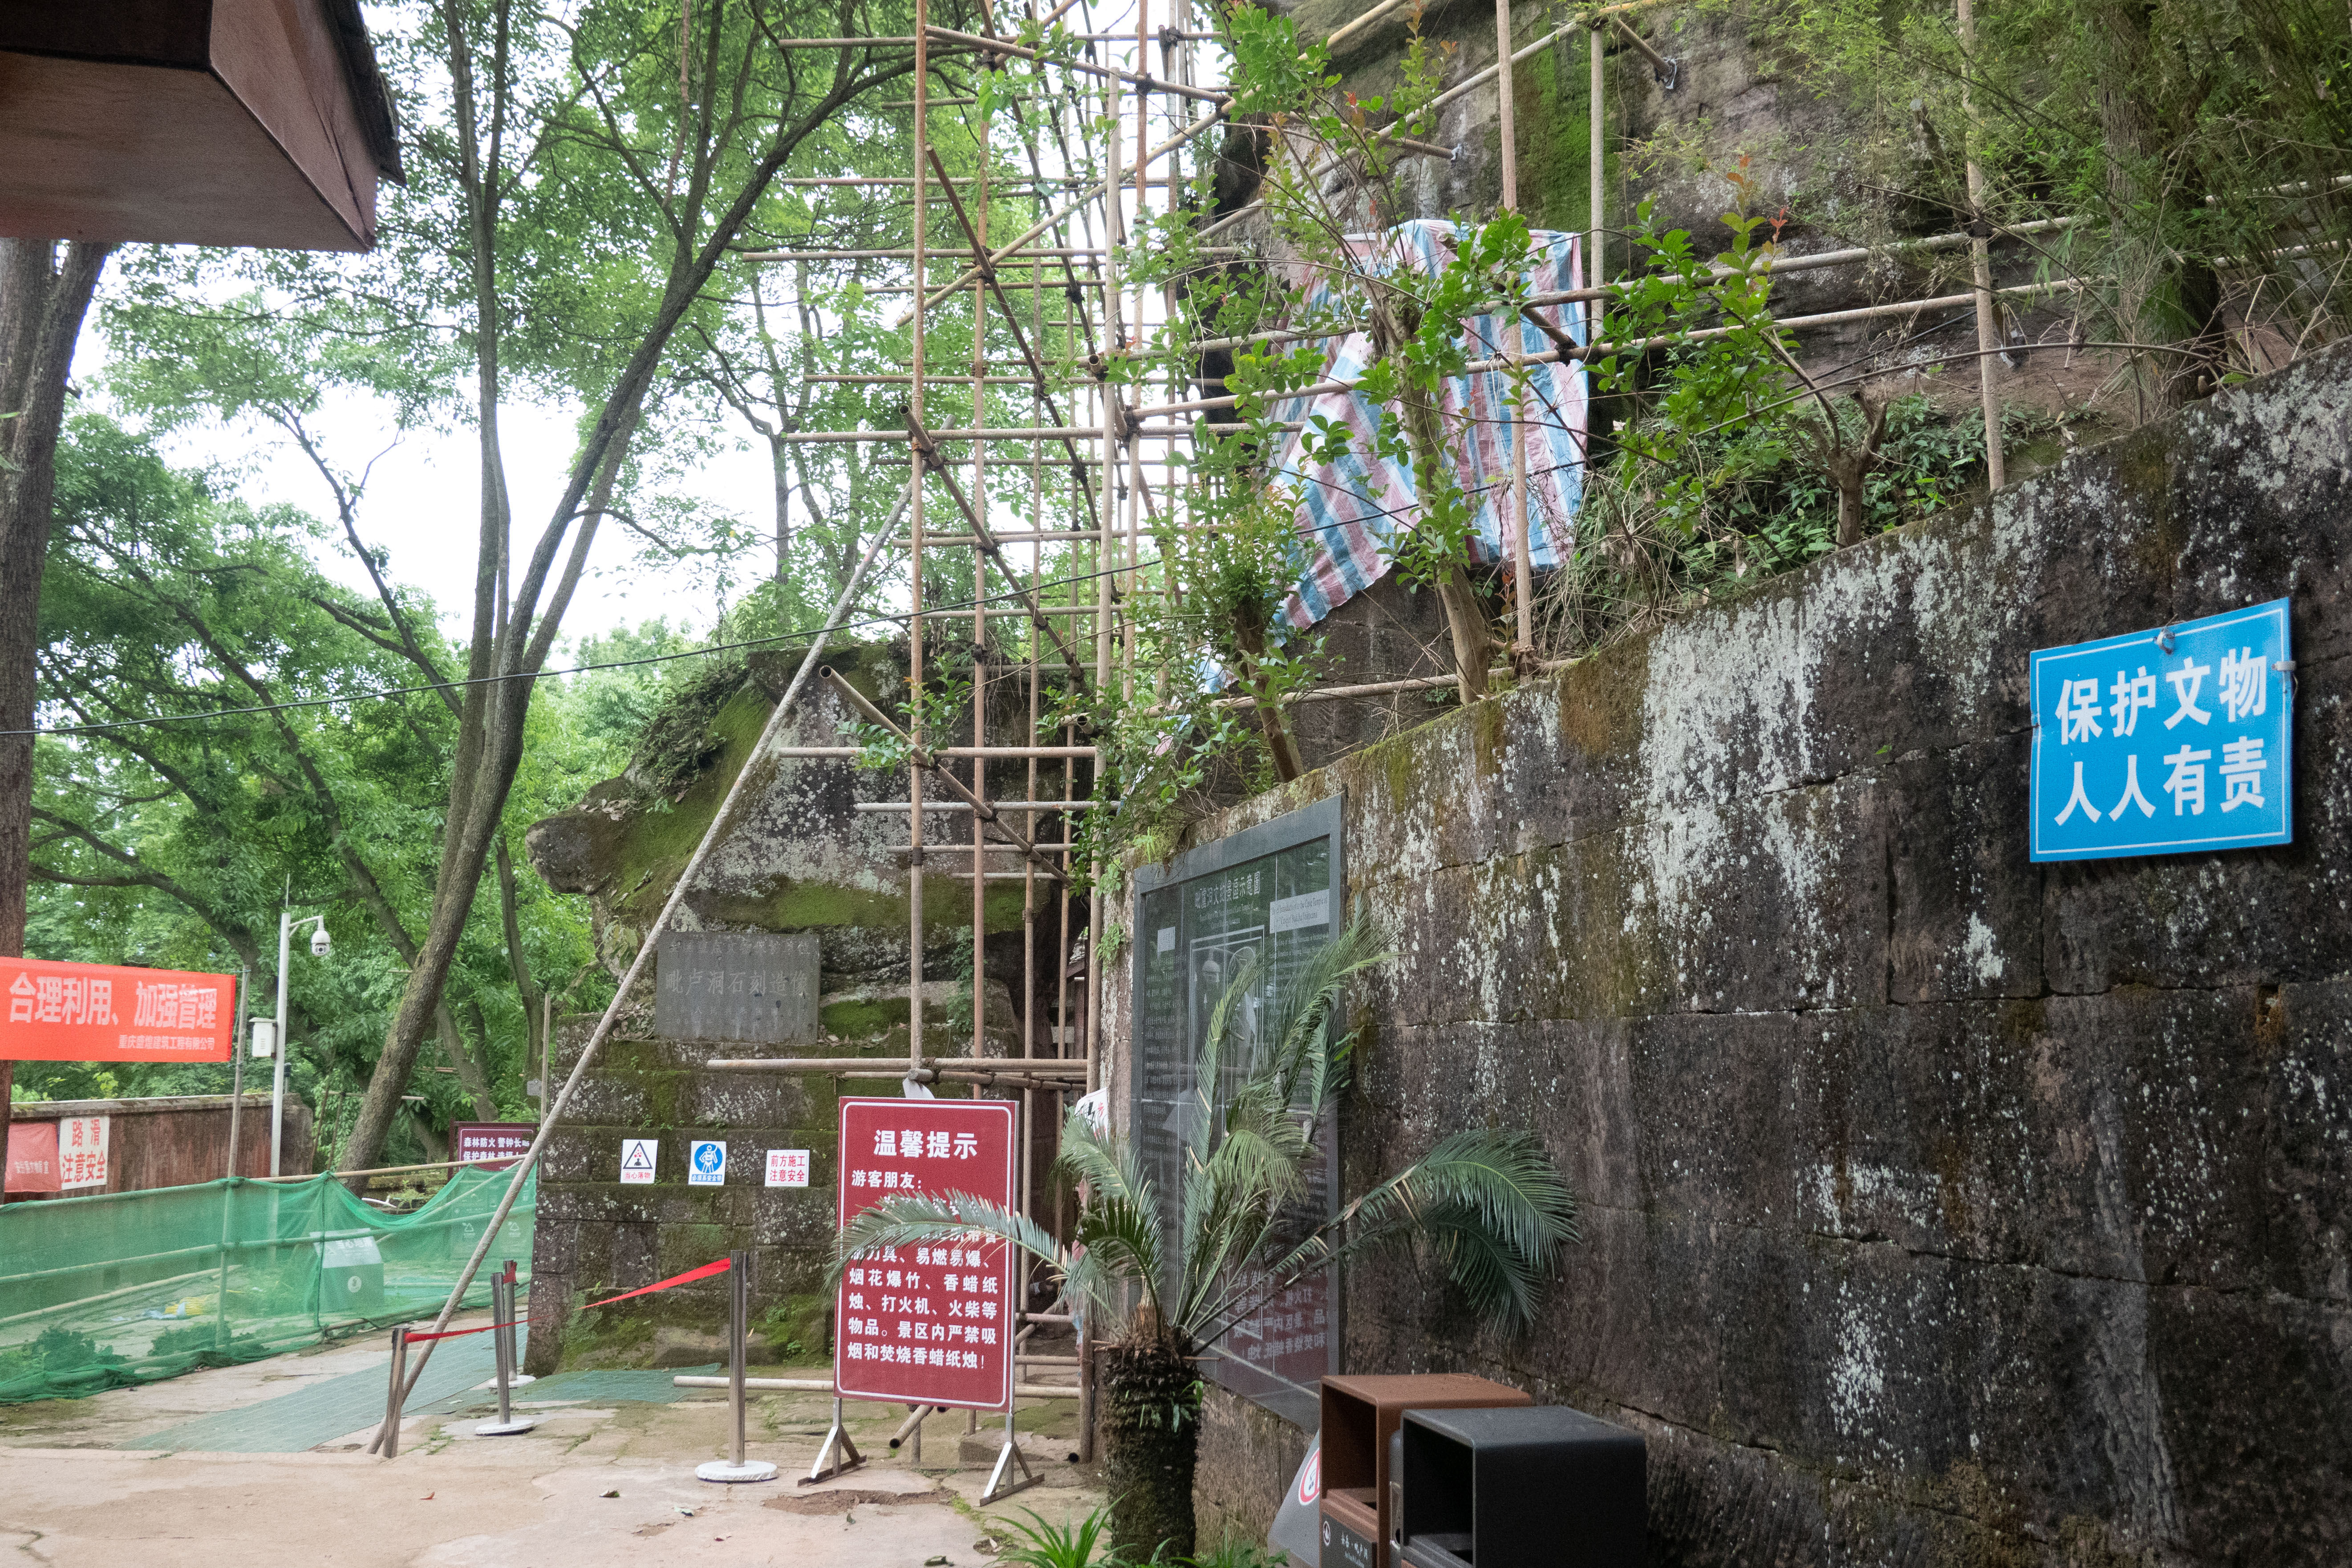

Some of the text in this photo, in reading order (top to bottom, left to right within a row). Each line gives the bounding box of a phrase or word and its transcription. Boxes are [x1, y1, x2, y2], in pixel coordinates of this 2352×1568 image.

[2055, 646, 2267, 746] 保护文物
[2054, 736, 2267, 826] 人人有责
[1313, 898, 1324, 907] Temple
[464, 1137, 495, 1148] 森林防火
[873, 1129, 978, 1160] 温馨提示
[61, 1150, 105, 1183] 注意安全
[771, 1154, 805, 1167] 前方施工
[625, 1171, 651, 1179] 当心落物
[770, 1169, 805, 1182] 注意安全
[851, 1169, 922, 1190] 游客朋友：
[848, 1317, 997, 1345] 物品。景区内严禁吸
